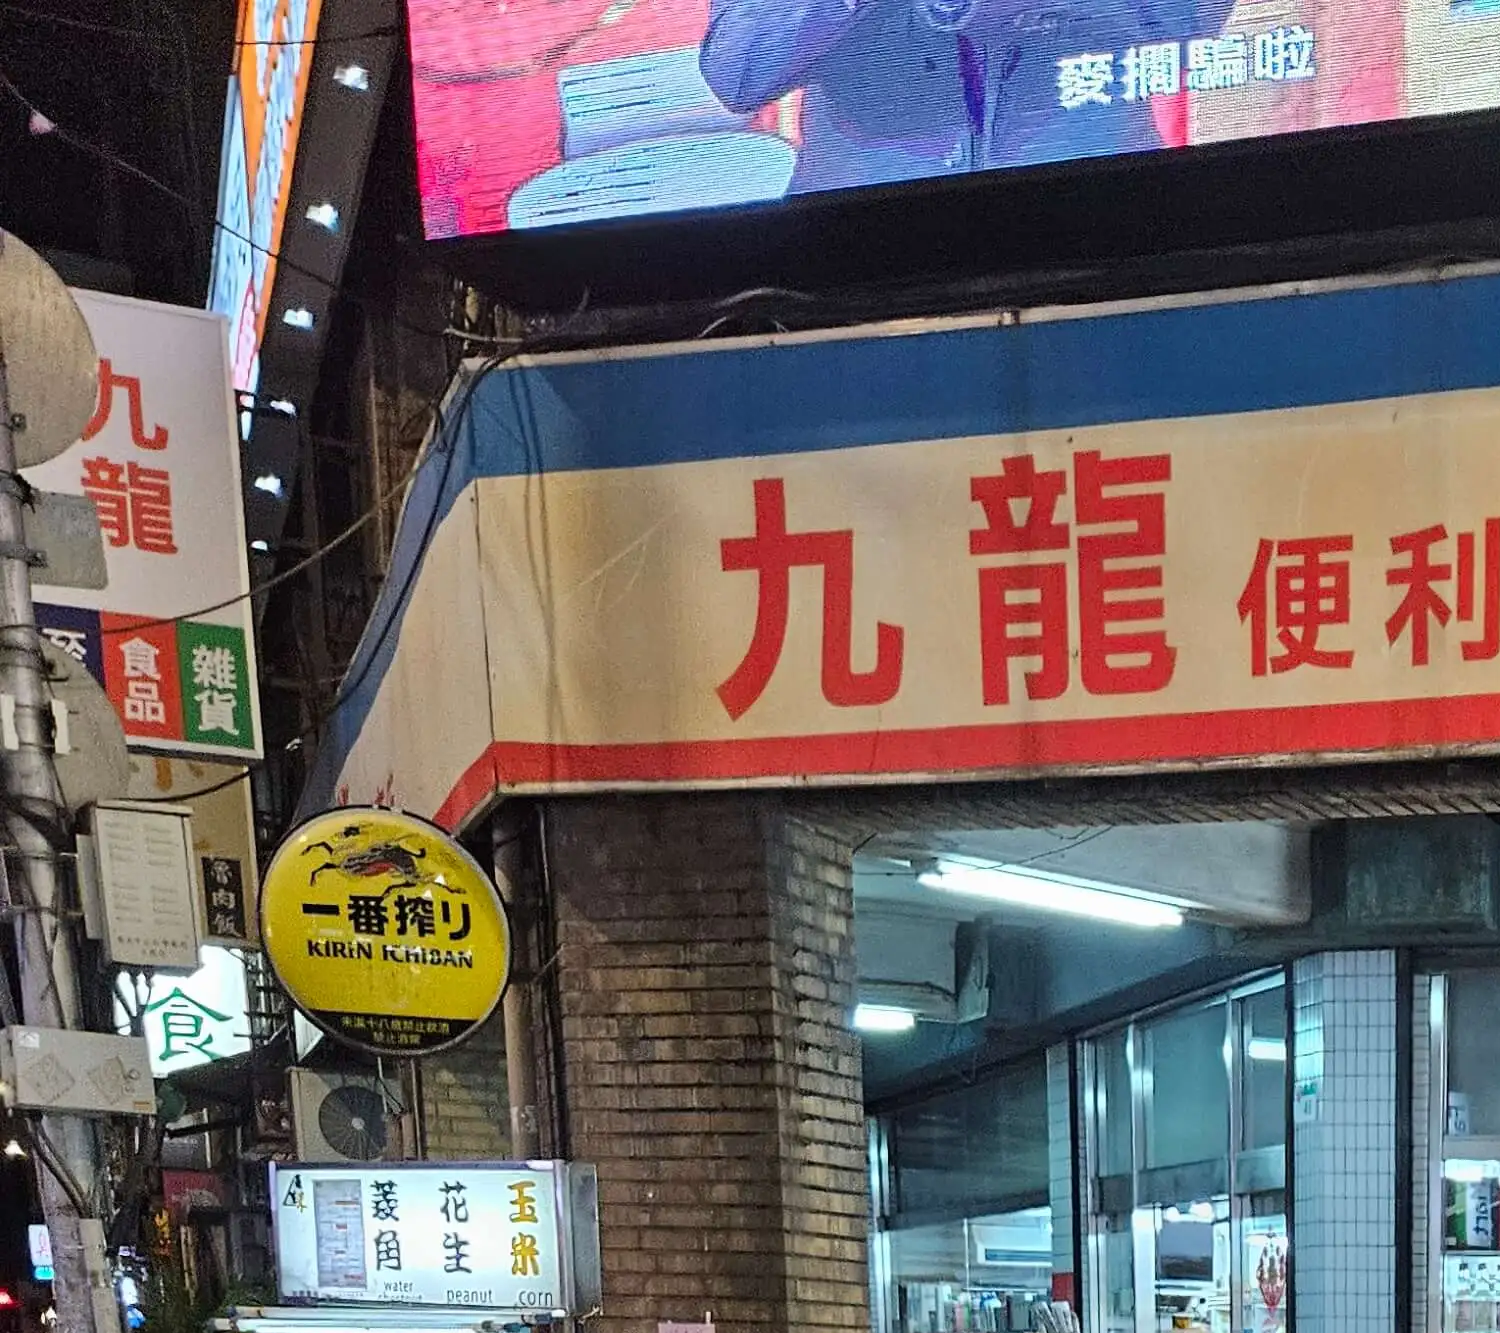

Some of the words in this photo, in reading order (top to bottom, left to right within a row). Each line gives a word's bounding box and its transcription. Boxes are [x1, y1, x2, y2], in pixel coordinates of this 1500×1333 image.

[117, 634, 166, 724] 食品
[191, 645, 240, 736] 雜貨
[307, 940, 373, 961] KIRIN
[382, 944, 474, 969] ICHIBAN
[145, 986, 234, 1062] 食
[438, 1181, 473, 1274] 花生
[507, 1180, 541, 1276] 玉米
[384, 1280, 413, 1293] water
[446, 1289, 493, 1305] peanut
[518, 1289, 554, 1307] corn
